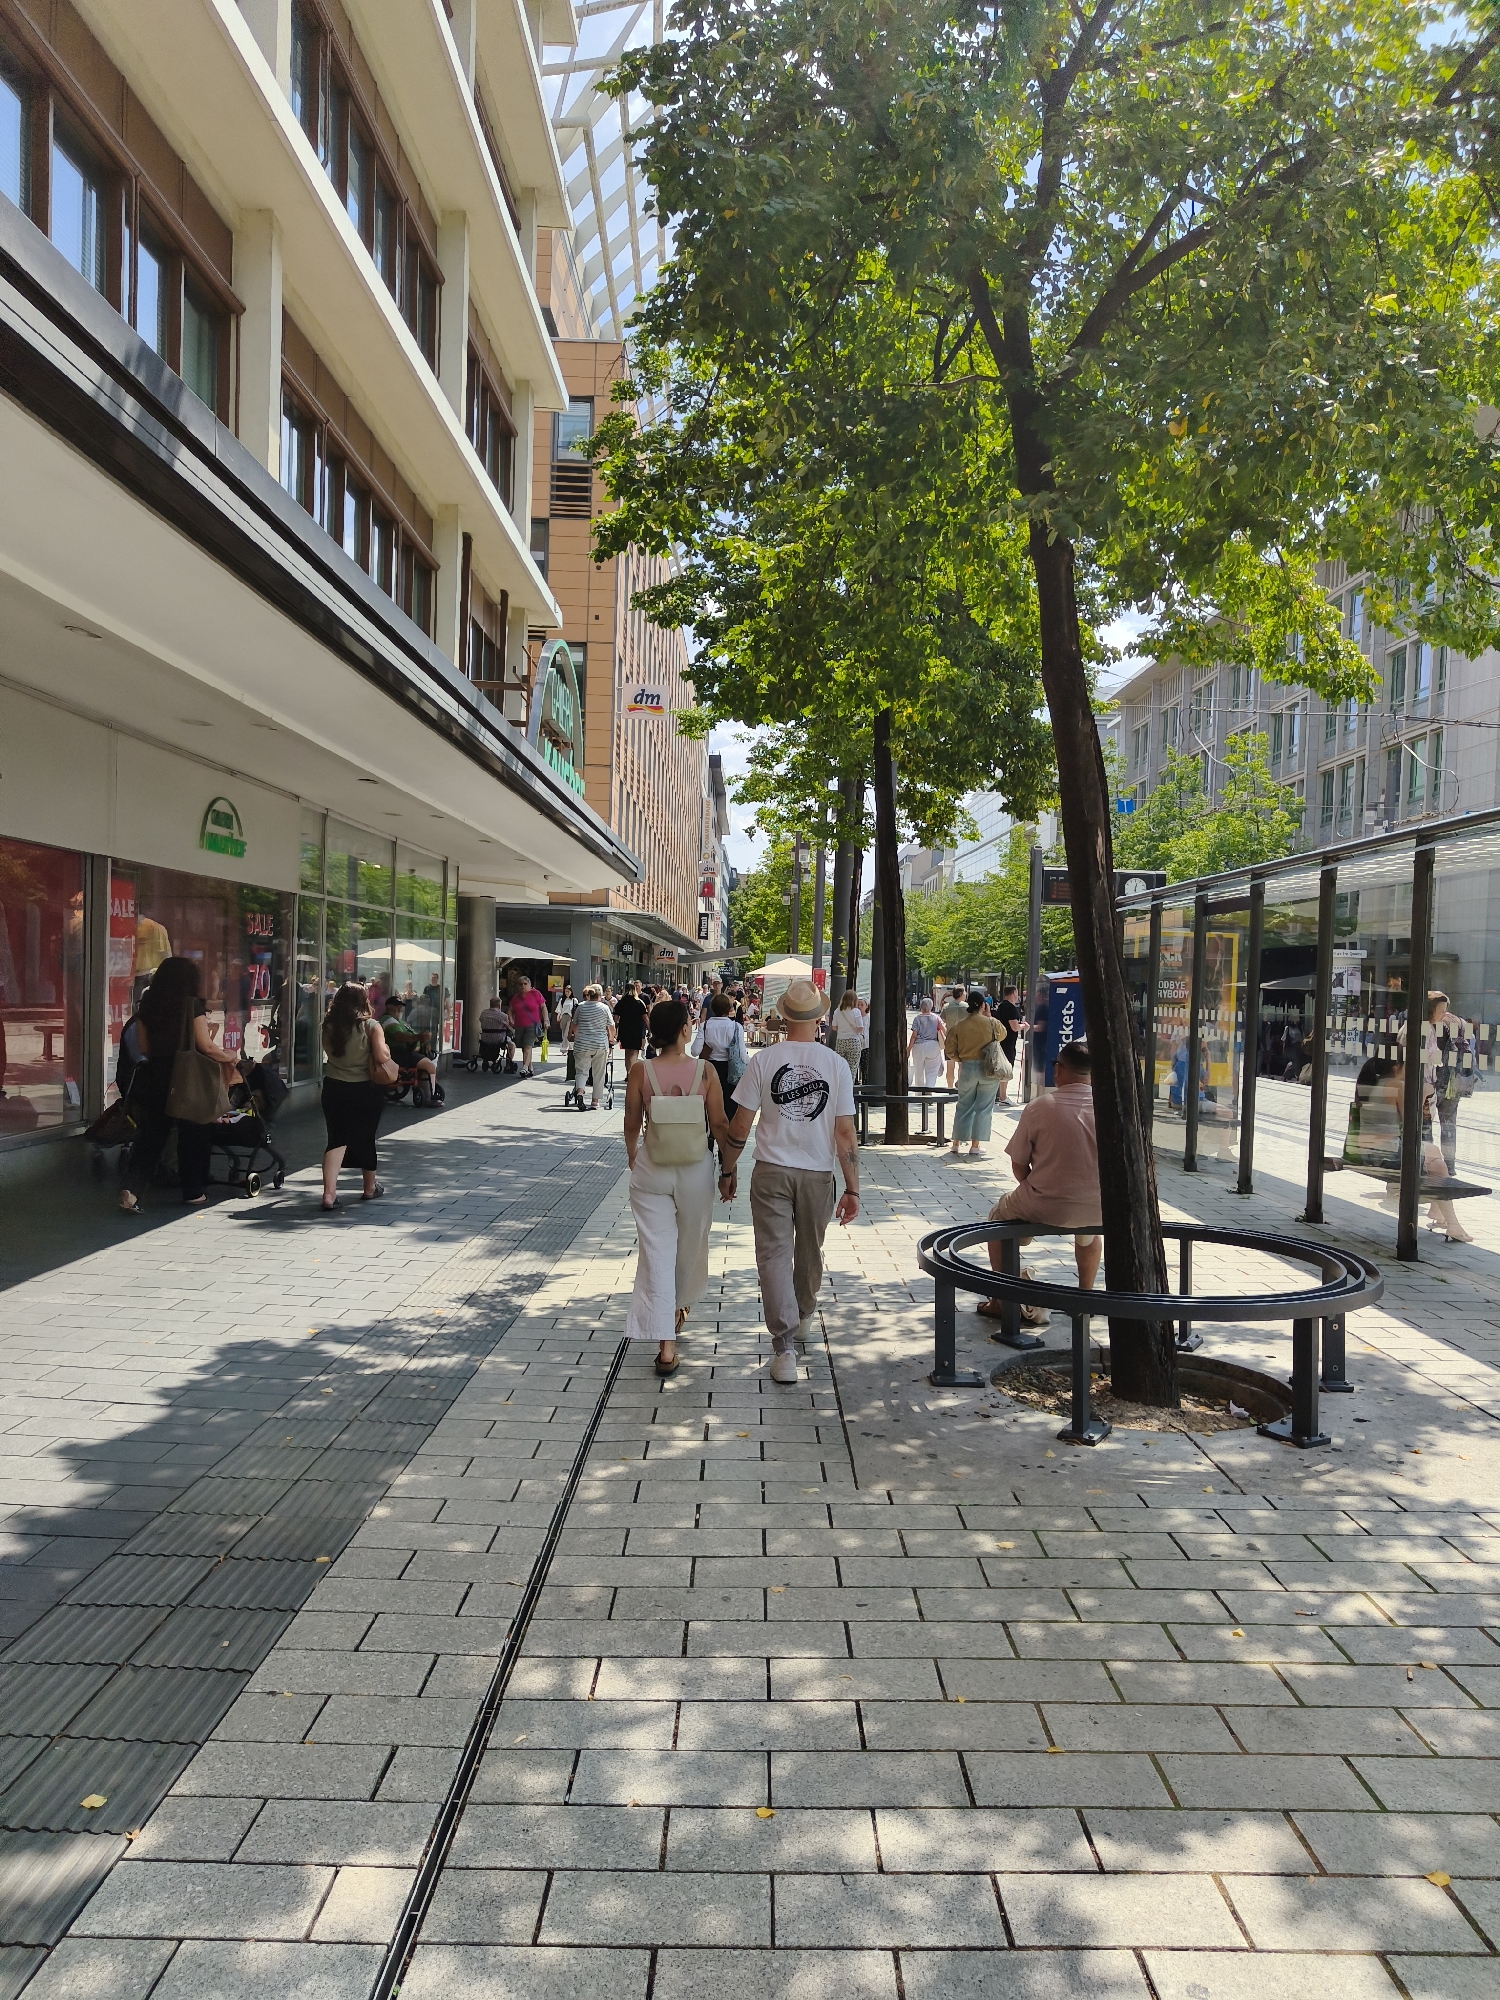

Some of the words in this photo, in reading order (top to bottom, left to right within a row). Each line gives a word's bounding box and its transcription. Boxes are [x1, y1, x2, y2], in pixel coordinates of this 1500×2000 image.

[633, 688, 661, 706] dm
[703, 864, 715, 872] dm
[246, 913, 274, 937] SALE
[660, 947, 674, 957] dm
[1158, 980, 1186, 990] ODBYE
[1157, 989, 1190, 999] RYBODY
[786, 1089, 801, 1100] LES
[802, 1082, 824, 1095] DEUX
